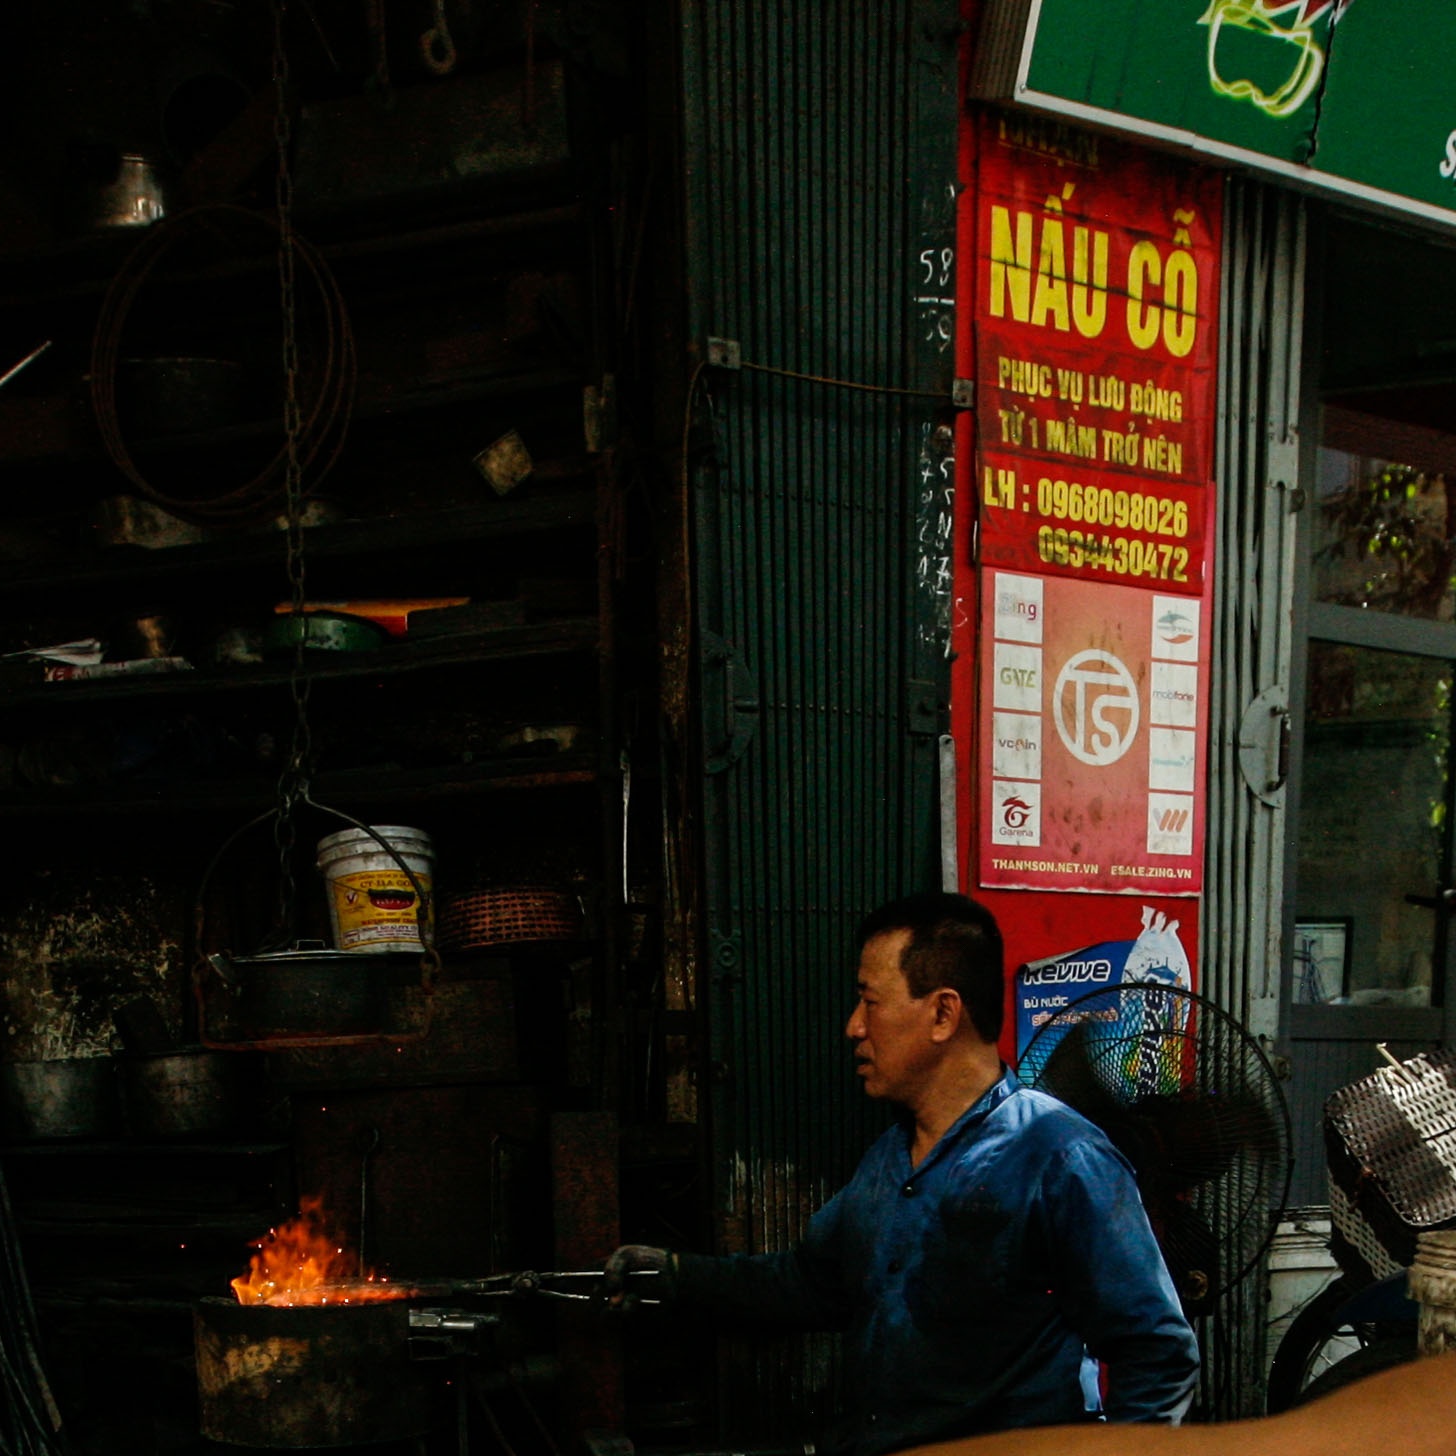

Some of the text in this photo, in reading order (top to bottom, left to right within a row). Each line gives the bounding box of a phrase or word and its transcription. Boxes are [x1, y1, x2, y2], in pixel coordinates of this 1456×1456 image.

[989, 182, 1198, 358] NẤU CỖ
[997, 356, 1183, 425] PHỤC VỤ LƯU ĐỘNG
[997, 407, 1183, 475] TỪ 1 MÂM TRỞ NÊN
[983, 466, 1016, 510] LH
[1037, 477, 1188, 538] 0968098026
[1037, 525, 1189, 583] 0934430472
[992, 858, 1192, 879] THANHSON.NET.VN ESALE.ZING.VN
